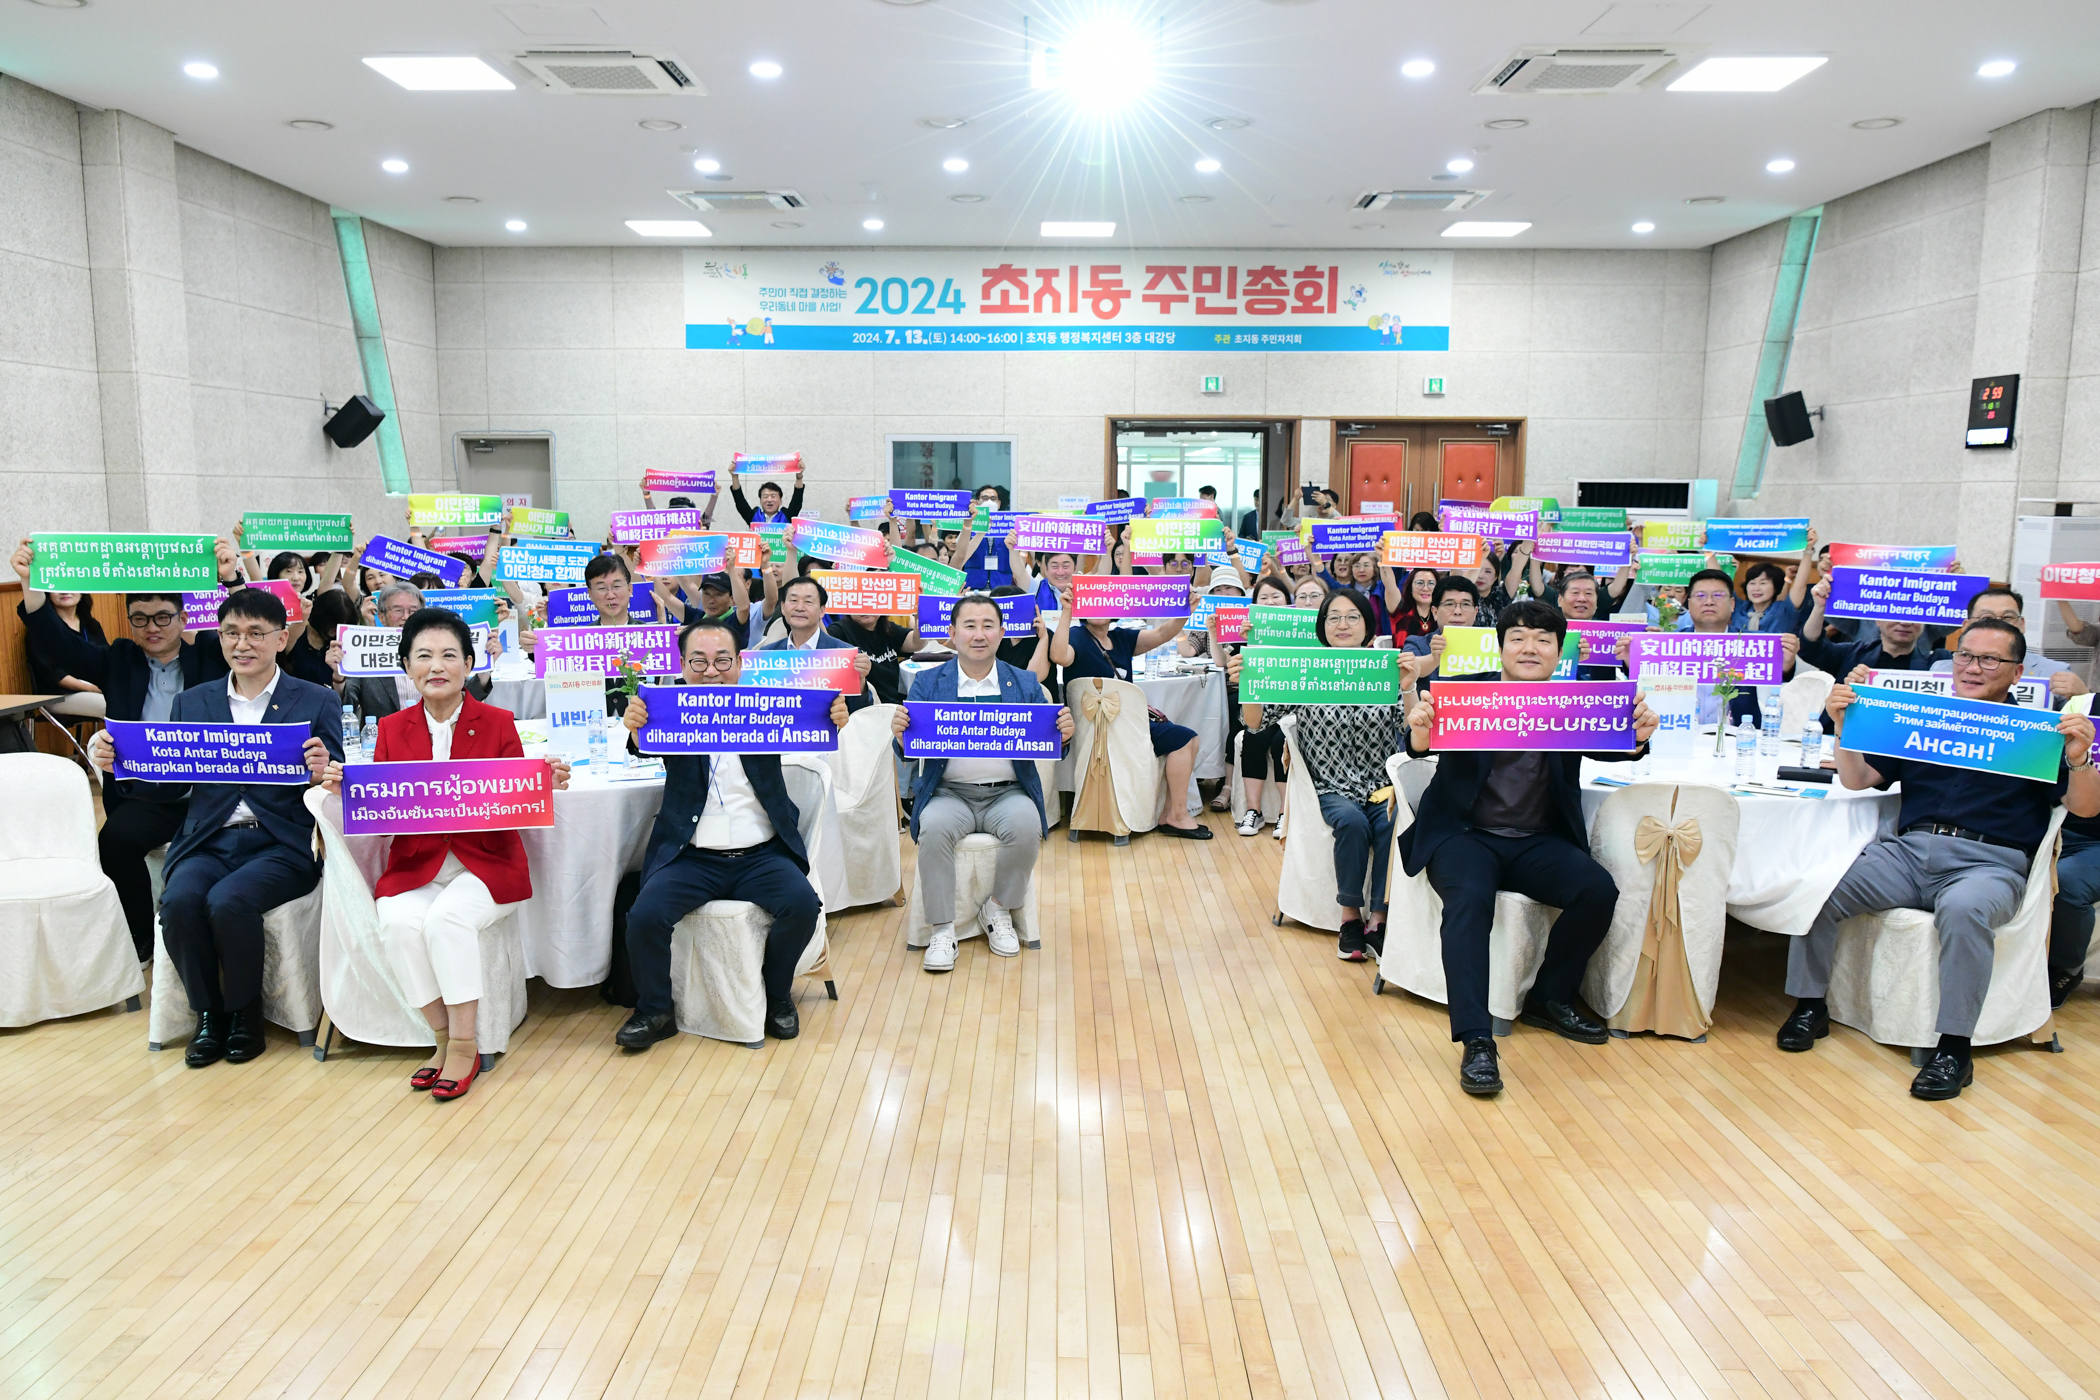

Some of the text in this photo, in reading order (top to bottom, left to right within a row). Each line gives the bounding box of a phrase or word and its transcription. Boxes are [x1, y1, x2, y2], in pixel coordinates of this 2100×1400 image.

[759, 287, 847, 299] 주민이 직접 결정하는
[854, 264, 1339, 320] 2024 초지동 주민총회
[759, 301, 841, 312] 우리동네 마을 사업!
[950, 332, 1018, 345] 14:00~16:00
[1026, 331, 1059, 345] 초지동
[1060, 331, 1122, 345] 행정복지센터
[1125, 332, 1142, 345] 3층
[1145, 331, 1177, 345] 대강당
[1214, 333, 1302, 346] 주관 초지동 주민자치회
[435, 498, 480, 511] 이민청!
[905, 493, 957, 502] Kantor Imigrant
[1509, 500, 1543, 510] 이민청!
[414, 511, 461, 523] 안산시가
[528, 511, 556, 524] 이민청!
[615, 512, 697, 527] 安山的新挑战!
[949, 509, 969, 517] Ansan
[513, 522, 544, 534] 안산시가
[1018, 520, 1102, 536] 安山的新挑战!
[1155, 522, 1200, 536] 이민청!
[1350, 525, 1380, 534] Imigrant
[742, 537, 756, 548] 길!
[1017, 534, 1101, 551] 和移民厅一起!
[1134, 537, 1222, 551] 안산시가 합니다!
[1389, 536, 1477, 549] 이민청! 안산의 길!
[1538, 538, 1625, 550] 안산의 길! 대한민국의 길!
[1647, 536, 1690, 548] 안산시가
[1735, 538, 1779, 549] Ансан!
[385, 541, 447, 568] Kantor Imigrant
[502, 549, 589, 567] 안산의 새로운 도전!
[684, 554, 724, 569] कार्यालय
[738, 550, 756, 564] 길!
[1388, 548, 1476, 564] 대한민국의 길!
[504, 564, 553, 579] 이민청과
[817, 576, 916, 592] 이민청! 안산의 길!
[1859, 574, 1957, 593] Kantor Imigrant
[896, 594, 916, 610] 길!
[1076, 593, 1187, 611] กรมการผู้อพยพ!
[1860, 588, 1949, 606] Kota Antar Budaya
[184, 603, 203, 612] Con
[453, 603, 473, 611] город
[570, 603, 585, 613] Kota
[1833, 599, 1968, 619] diharapkan berada di Ansa
[554, 614, 591, 625] diharapkan
[1003, 621, 1032, 632] Ansan
[544, 629, 671, 652] 安山的新挑战!
[1640, 638, 1774, 658] 安山的新挑战!
[790, 655, 851, 675] आप्रवासी
[678, 692, 802, 711] Kantor Imigrant
[1438, 692, 1629, 710] เมืองอันซันจะเป็นผู้จัดการ!
[2017, 685, 2034, 703] 길
[934, 709, 1032, 724] Kantor Imigrant
[1855, 694, 2009, 726] Управление миграционной
[681, 712, 794, 728] Kota Antar Budaya
[1439, 712, 1628, 737] กรมการผู้อพยพ!
[1893, 713, 2015, 742] Этим займётся город
[145, 728, 273, 746] Kantor Imigrant
[646, 728, 830, 745] diharapkan berada di Ansan
[937, 725, 1026, 738] Kota Antar Budaya
[910, 739, 1054, 752] diharapkan berada di Ansan
[1904, 731, 1995, 761] Ансан!
[152, 746, 267, 762] Kota Antar Budaya
[123, 760, 305, 776] diharapkan berada di Ansan
[350, 772, 543, 803] กรมการผู้อพยพ!
[351, 799, 546, 822] เมืองอันซันจะเป็นผู้จัดการ!
